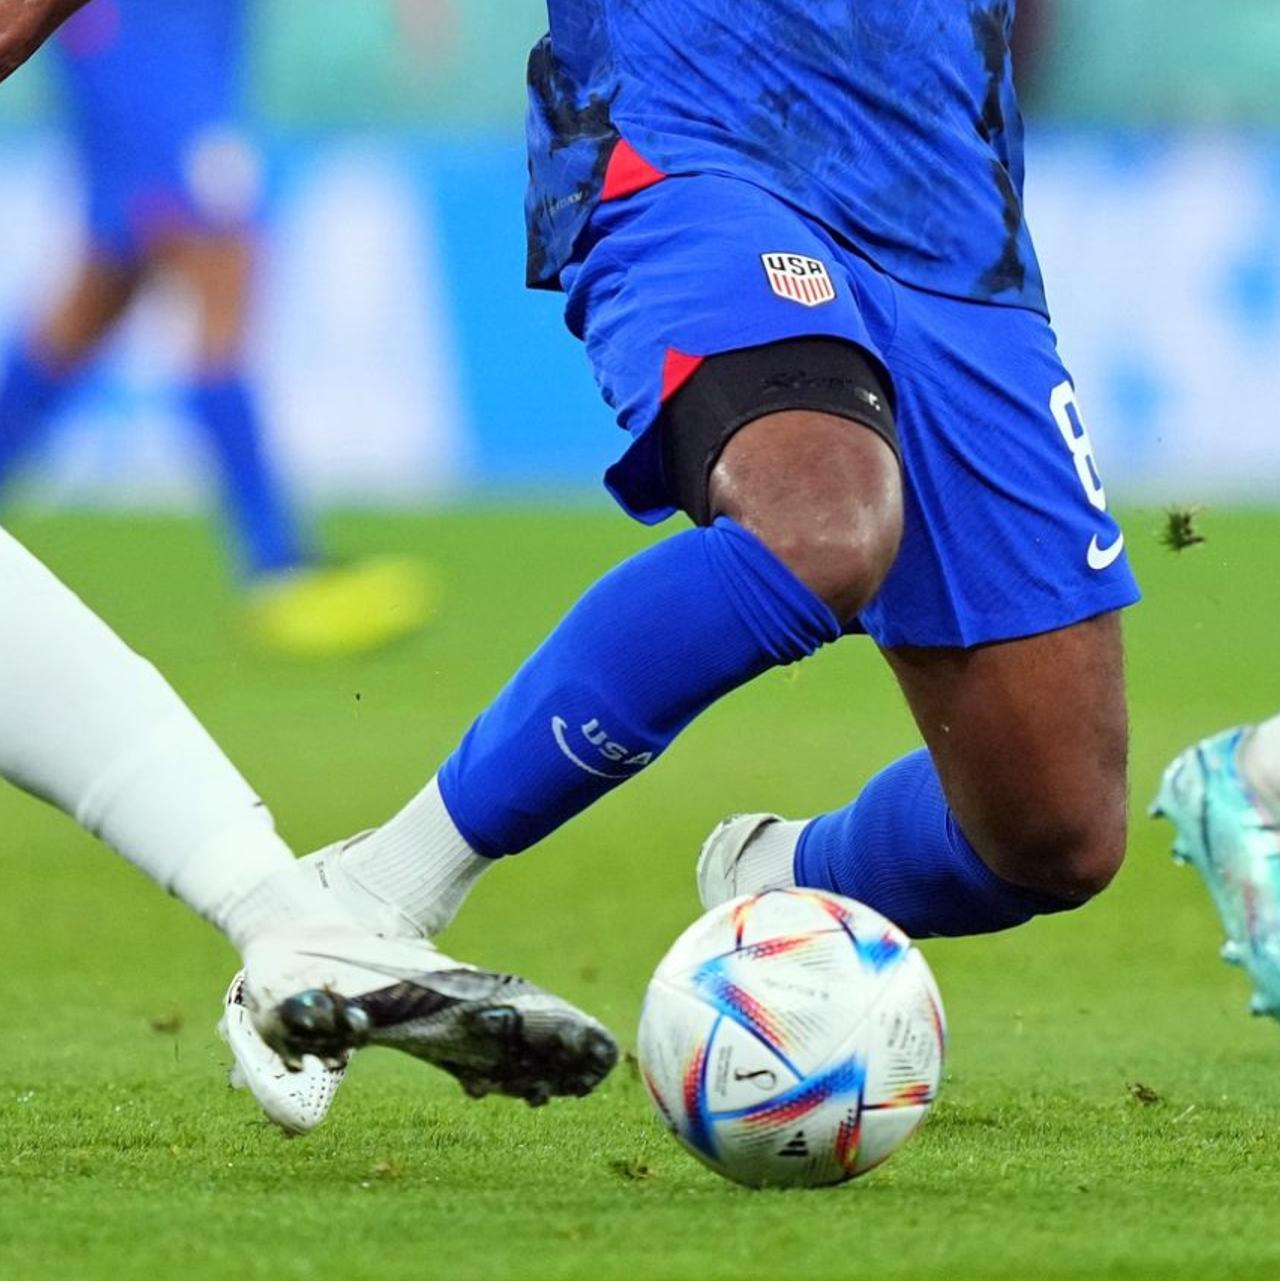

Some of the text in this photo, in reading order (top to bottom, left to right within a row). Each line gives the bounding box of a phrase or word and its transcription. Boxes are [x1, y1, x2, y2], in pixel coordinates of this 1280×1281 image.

[767, 256, 823, 276] USA
[1048, 380, 1107, 513] 8
[581, 718, 653, 765] USA
